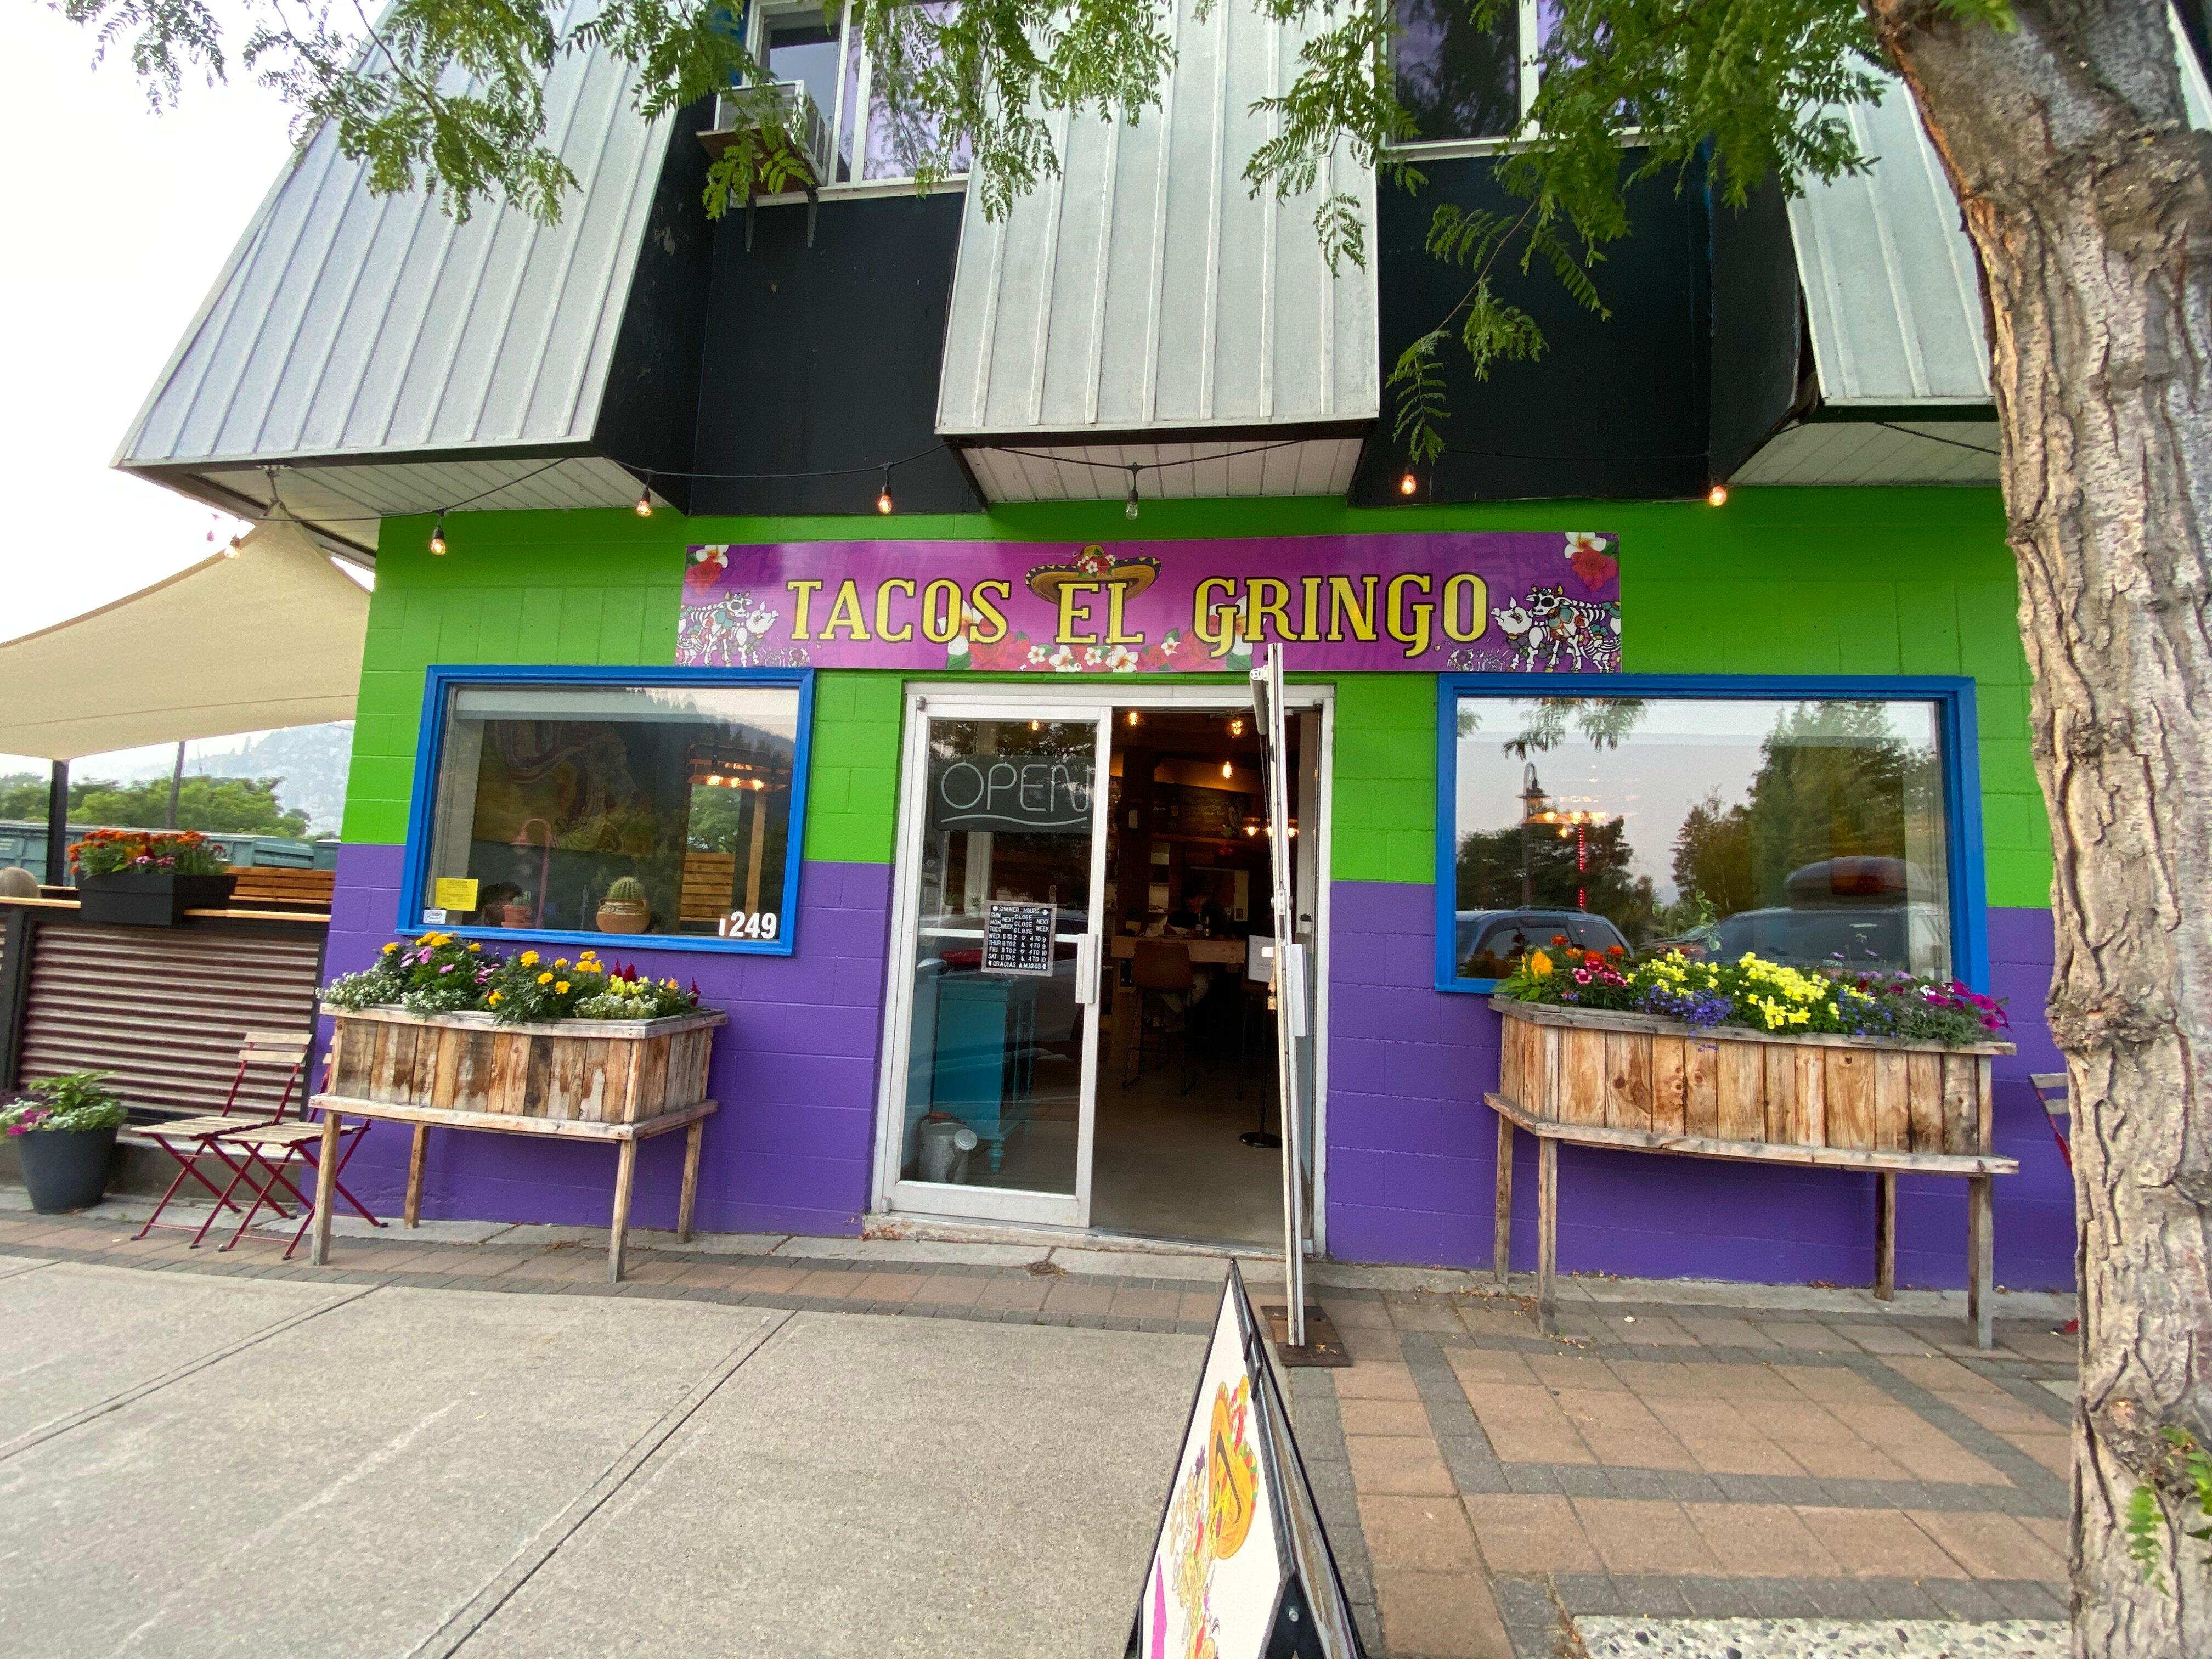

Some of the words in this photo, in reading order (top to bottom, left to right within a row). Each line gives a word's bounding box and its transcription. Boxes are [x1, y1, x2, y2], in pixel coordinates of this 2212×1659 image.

[786, 577, 1012, 644] TACOS
[1054, 579, 1145, 645] EL
[1192, 572, 1489, 659] GRINGO
[941, 762, 1090, 812] OPEN
[719, 911, 777, 939] 1249
